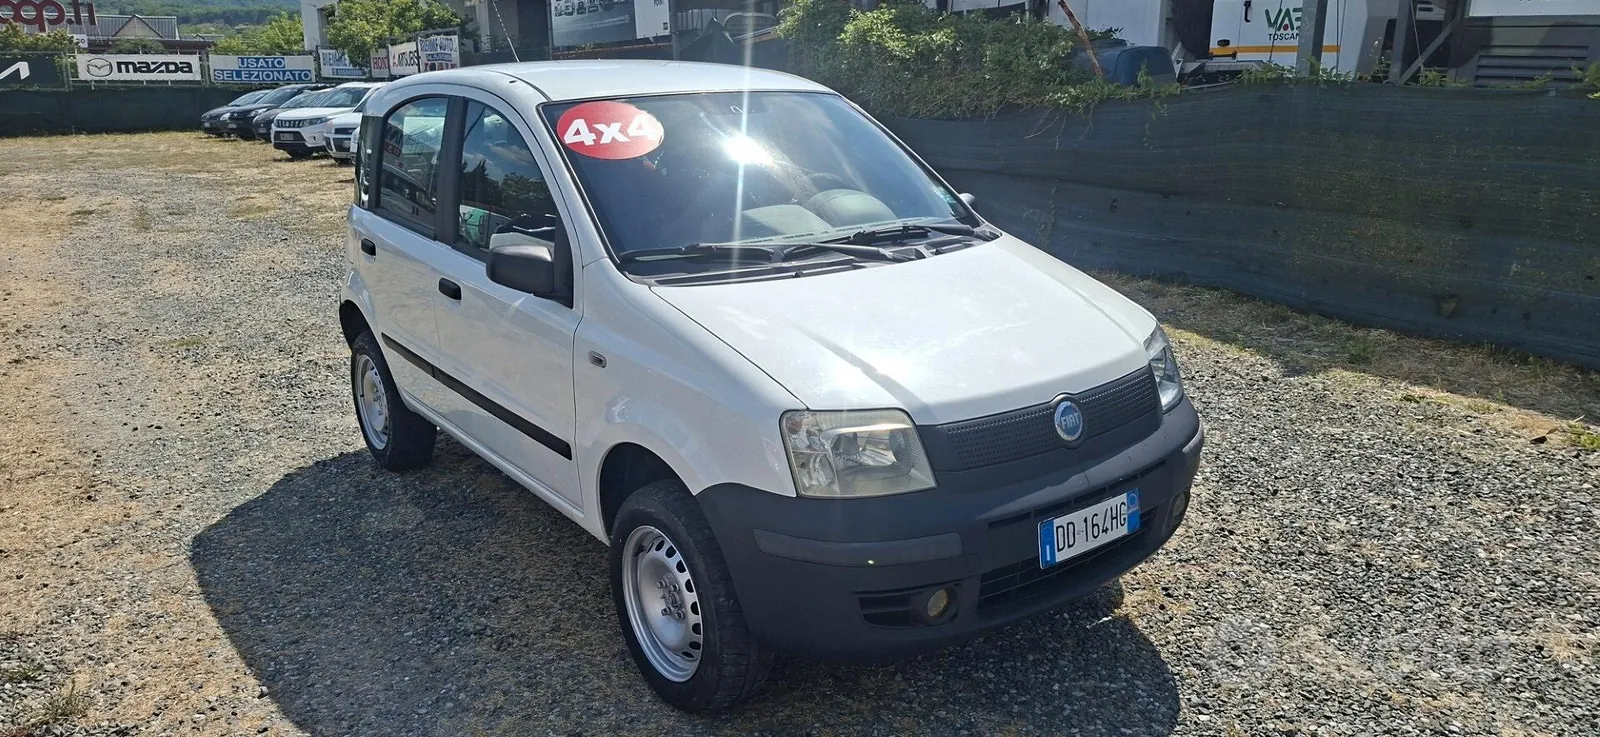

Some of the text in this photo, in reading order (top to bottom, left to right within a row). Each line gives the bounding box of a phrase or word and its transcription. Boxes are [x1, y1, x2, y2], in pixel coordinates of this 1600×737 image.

[239, 57, 285, 69] USATO
[214, 70, 312, 82] SELEZIONATO
[563, 113, 659, 147] 4x4
[1061, 413, 1079, 429] FIAT
